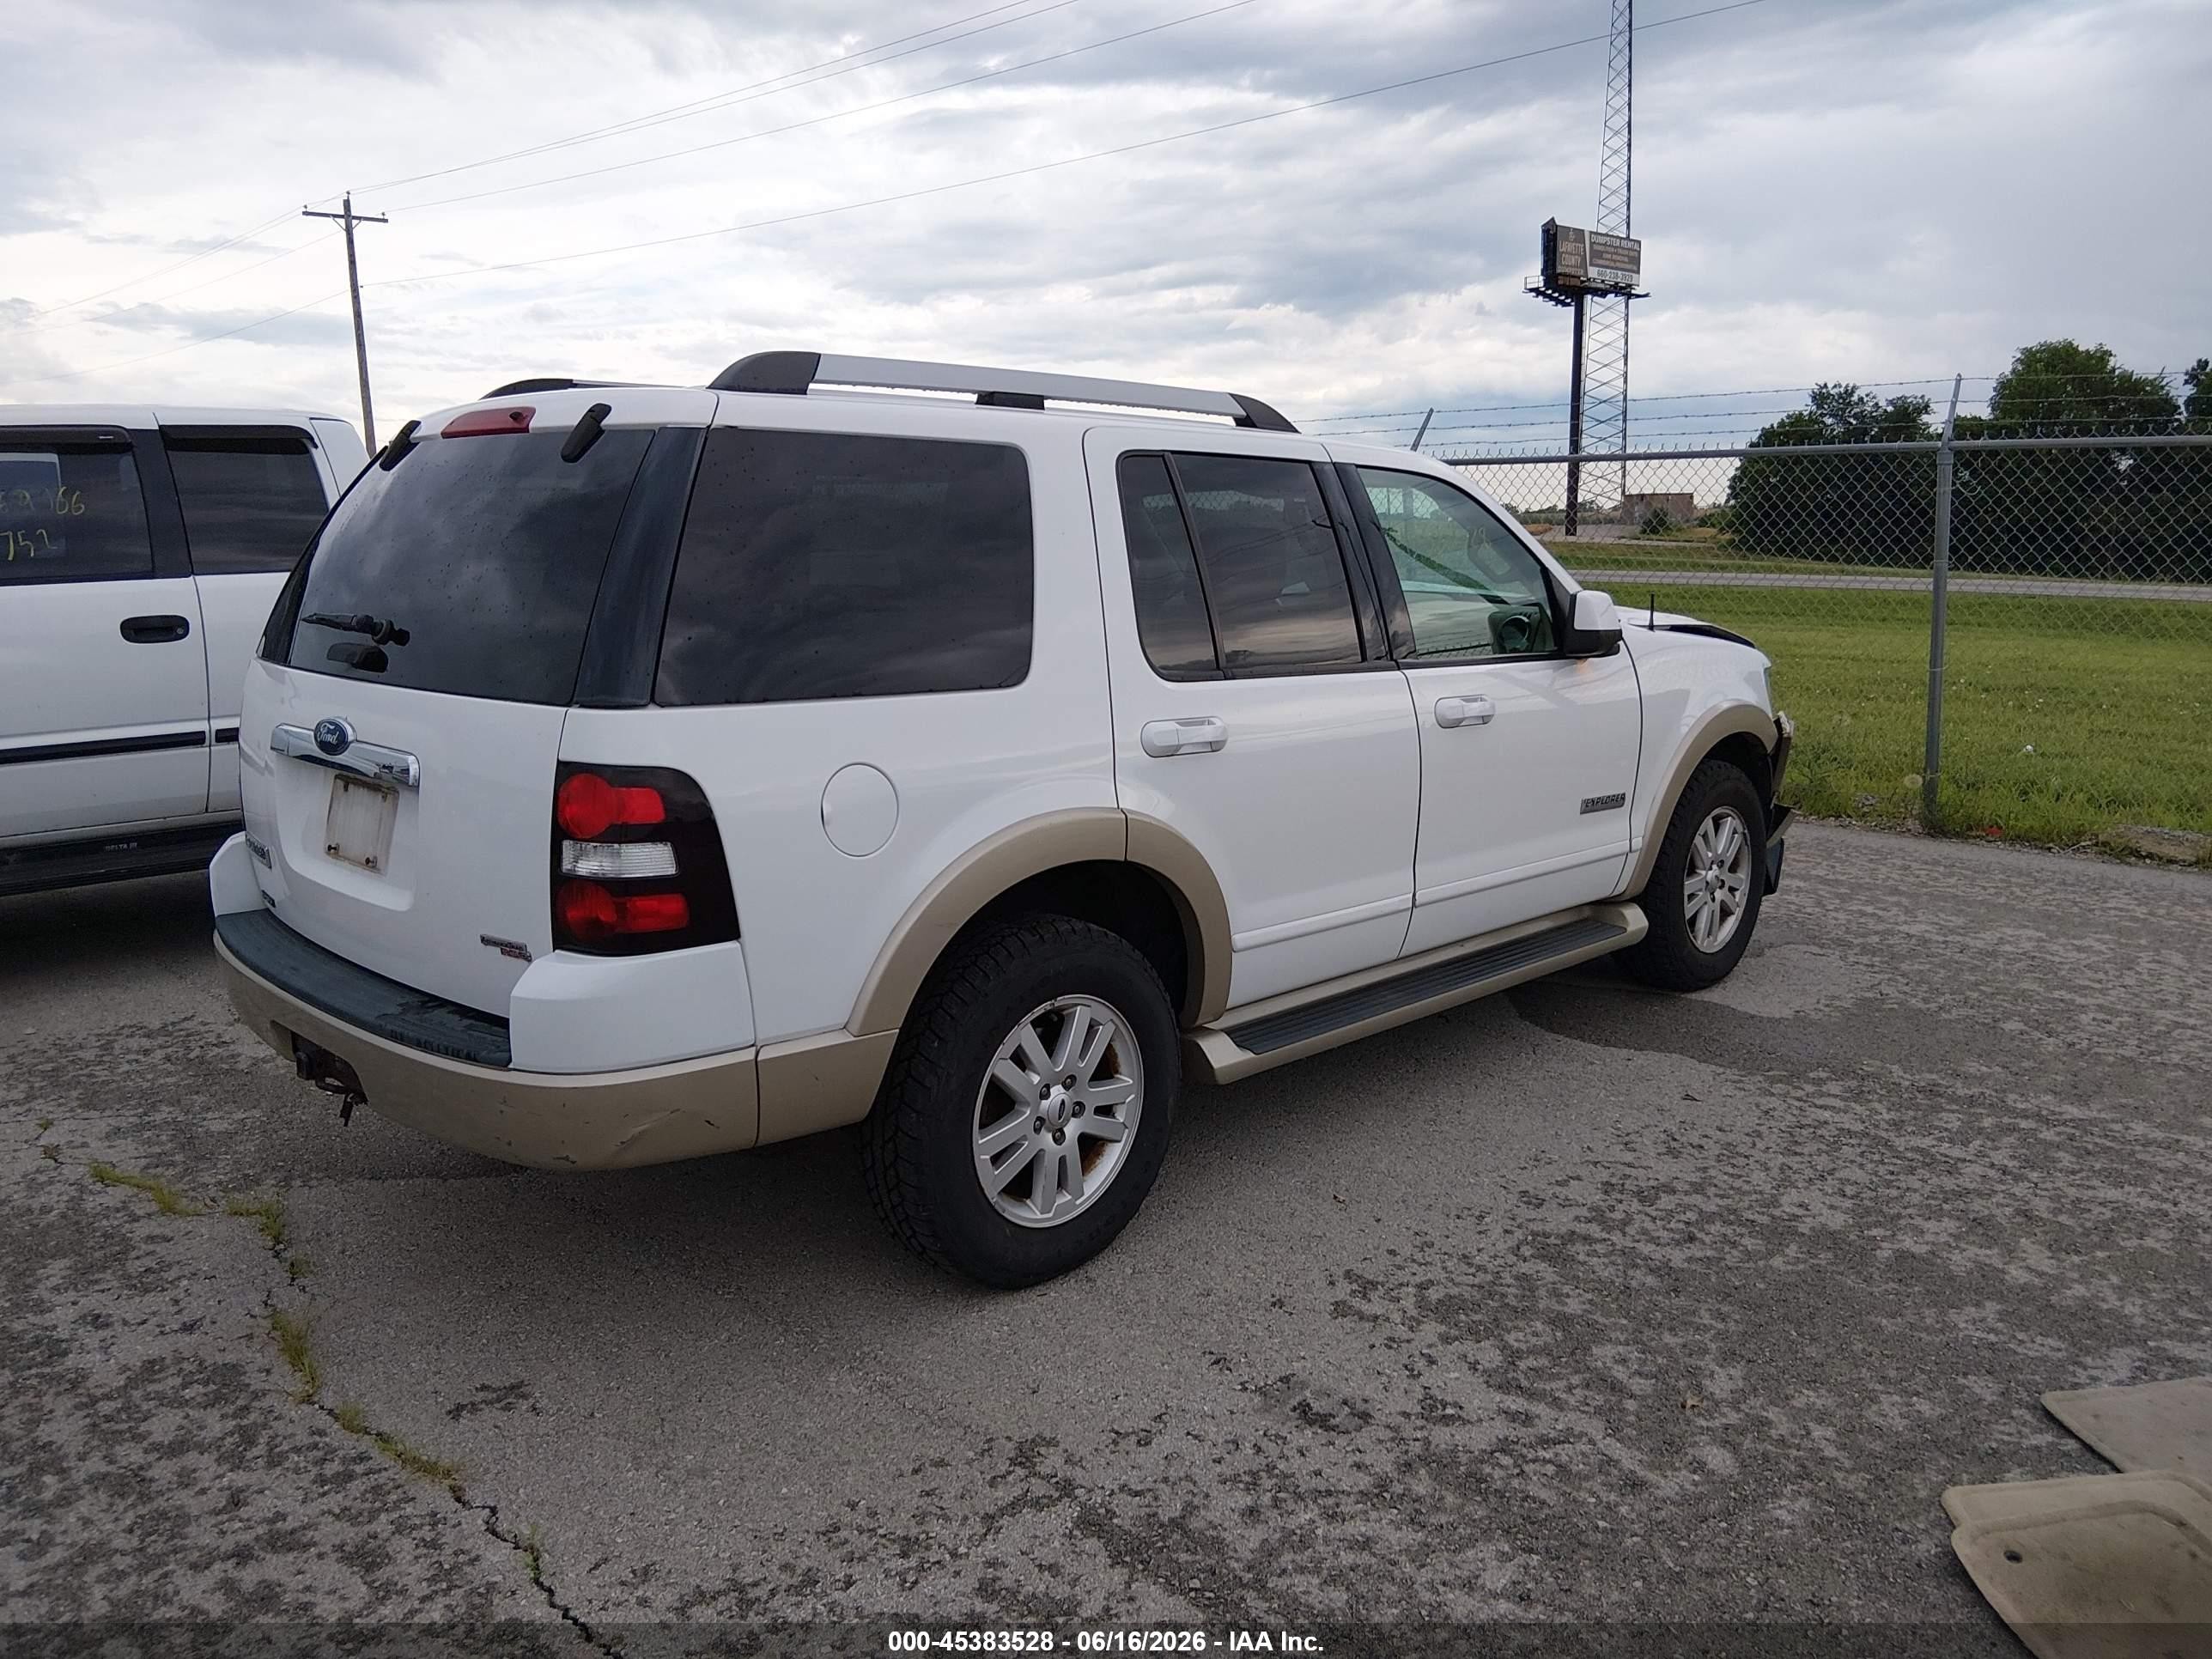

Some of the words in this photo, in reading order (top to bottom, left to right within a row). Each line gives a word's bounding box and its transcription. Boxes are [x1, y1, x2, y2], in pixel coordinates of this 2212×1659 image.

[1559, 240, 1584, 255] LAFAYETTE
[1591, 234, 1620, 246] DUMPSTER
[1621, 240, 1640, 251] RENTAL
[1561, 254, 1581, 268] COUNTY
[317, 722, 339, 745] Ford
[1585, 793, 1626, 807] EXPLORER
